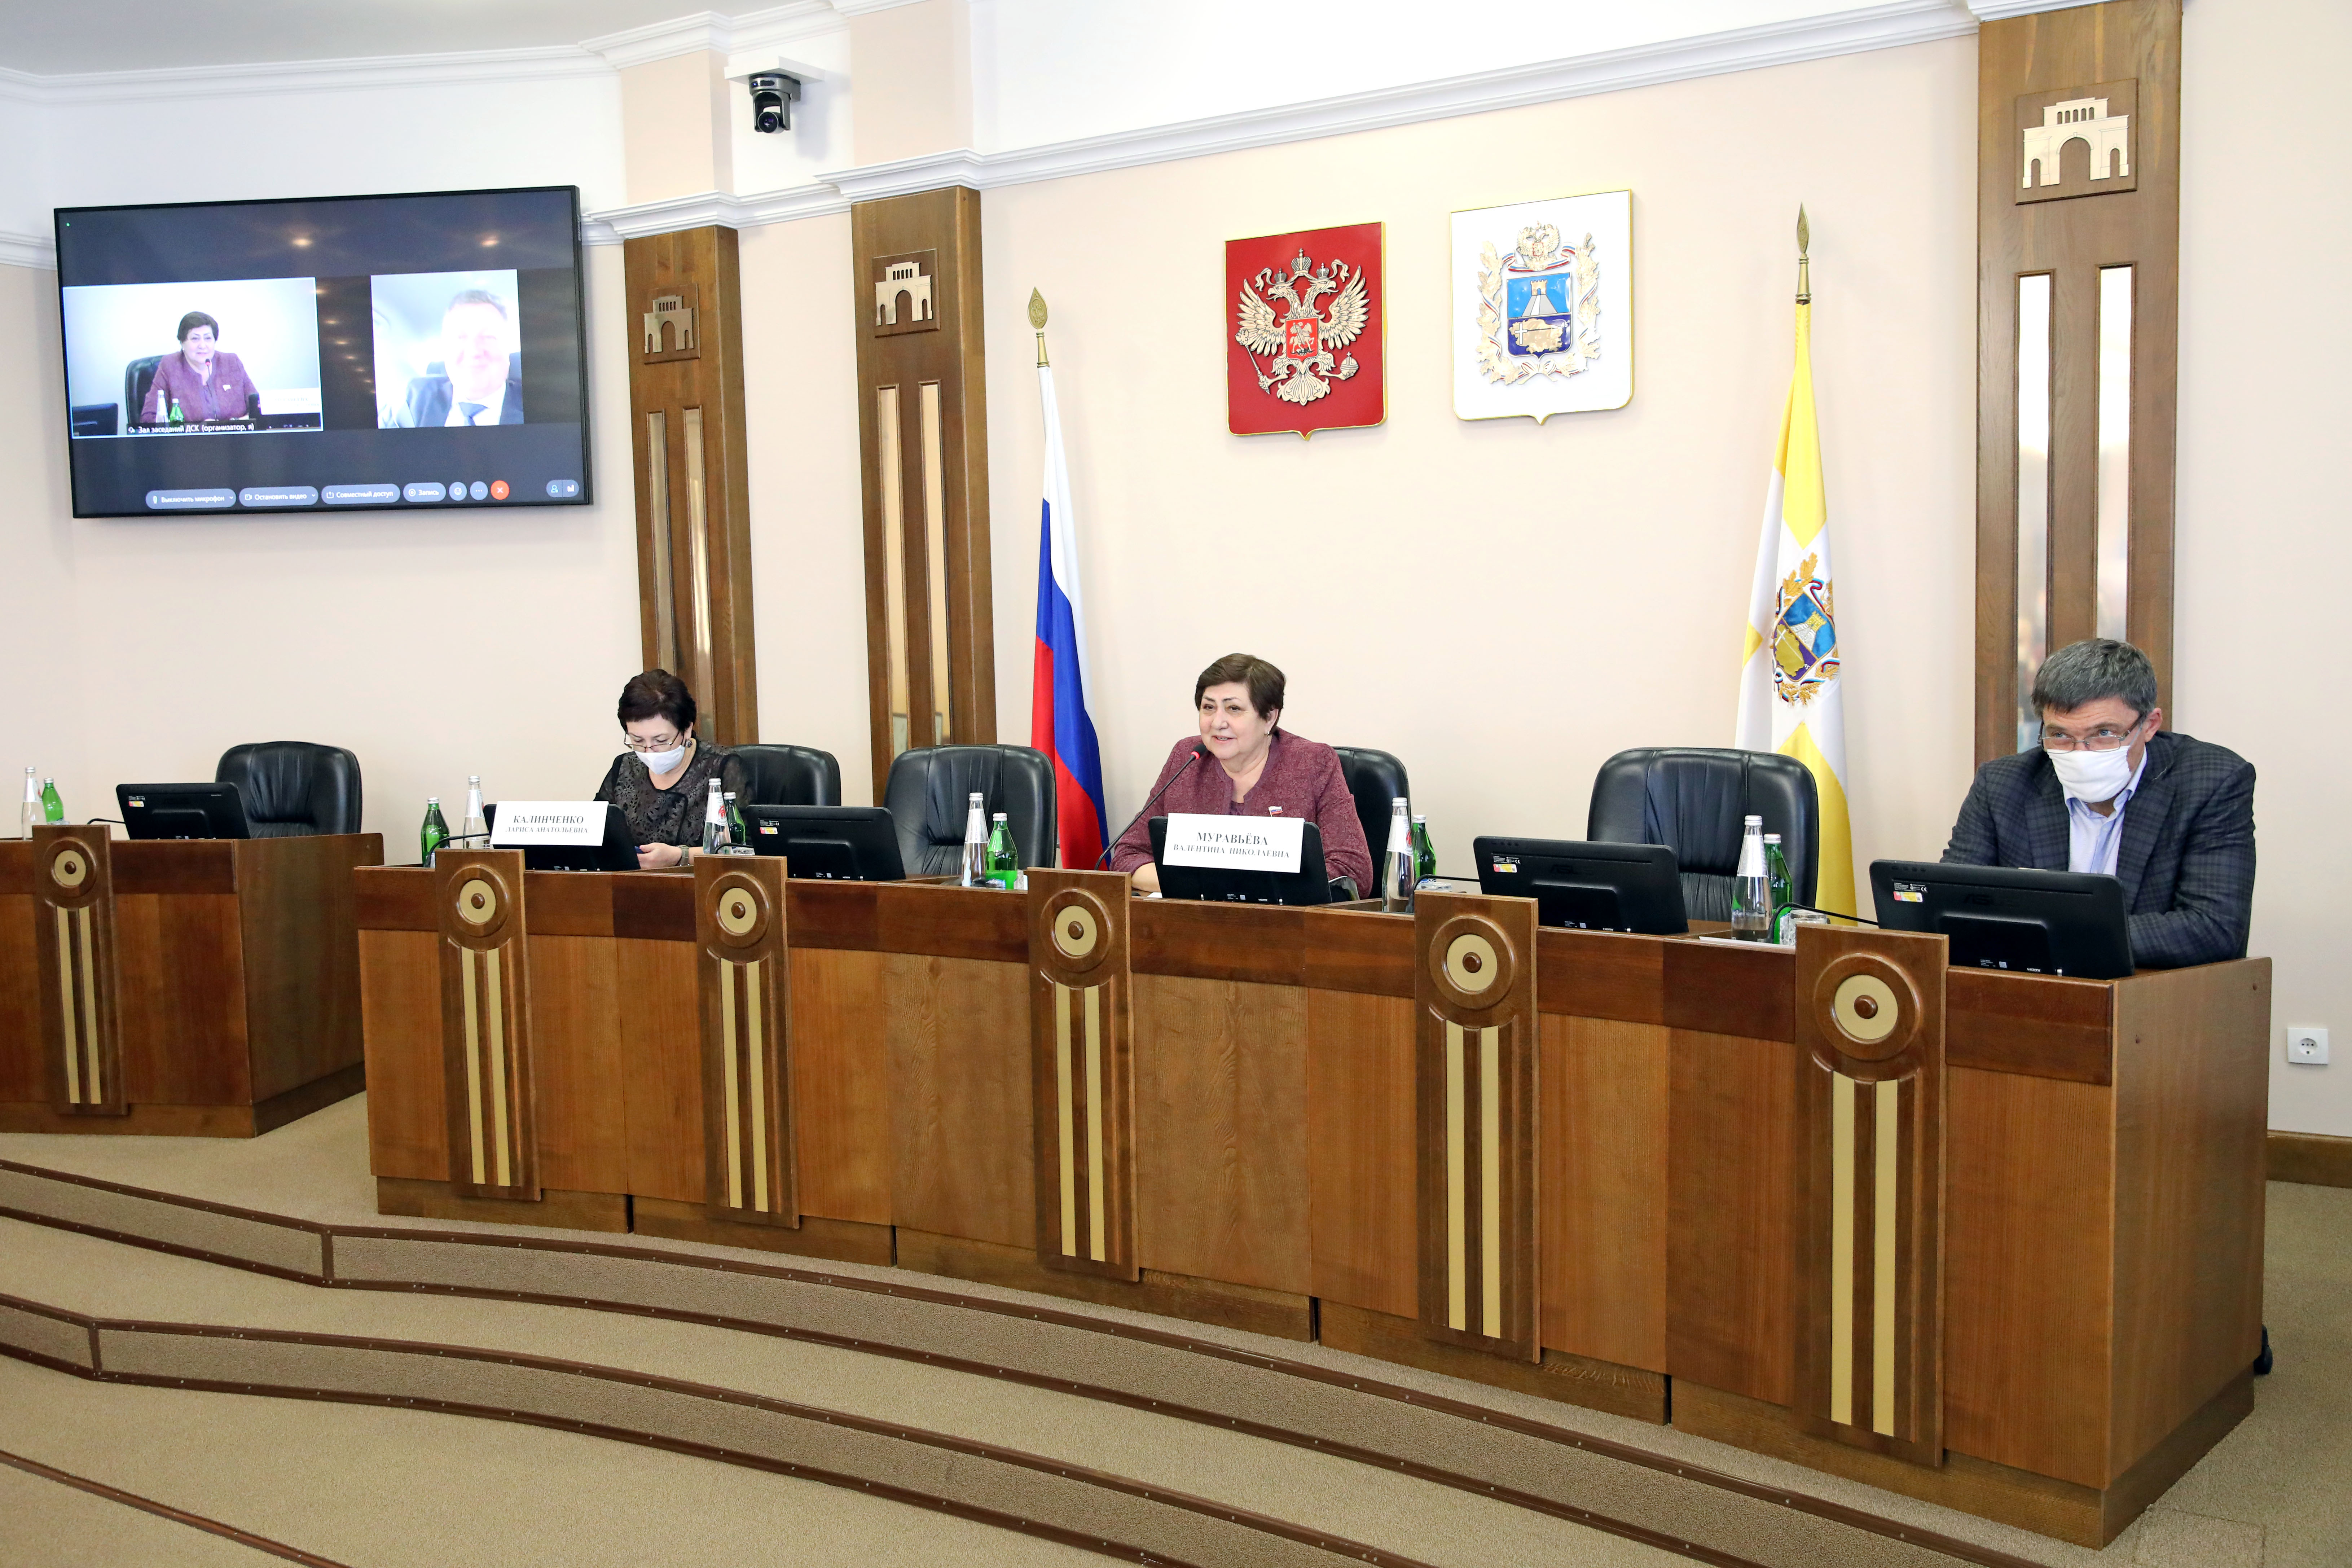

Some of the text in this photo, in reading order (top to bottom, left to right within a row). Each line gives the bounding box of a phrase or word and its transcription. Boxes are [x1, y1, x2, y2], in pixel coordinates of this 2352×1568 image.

[151, 425, 184, 433] заседаний
[185, 425, 199, 433] ДСК
[201, 424, 247, 432] (организатор,
[248, 422, 254, 431] я)
[513, 815, 584, 824] КАЛИНЧЕНКО
[1196, 832, 1268, 845] МУРАВЬЁВА
[1173, 844, 1290, 858] ВАЛЕНТИНА НИКОЛАЕВНА
